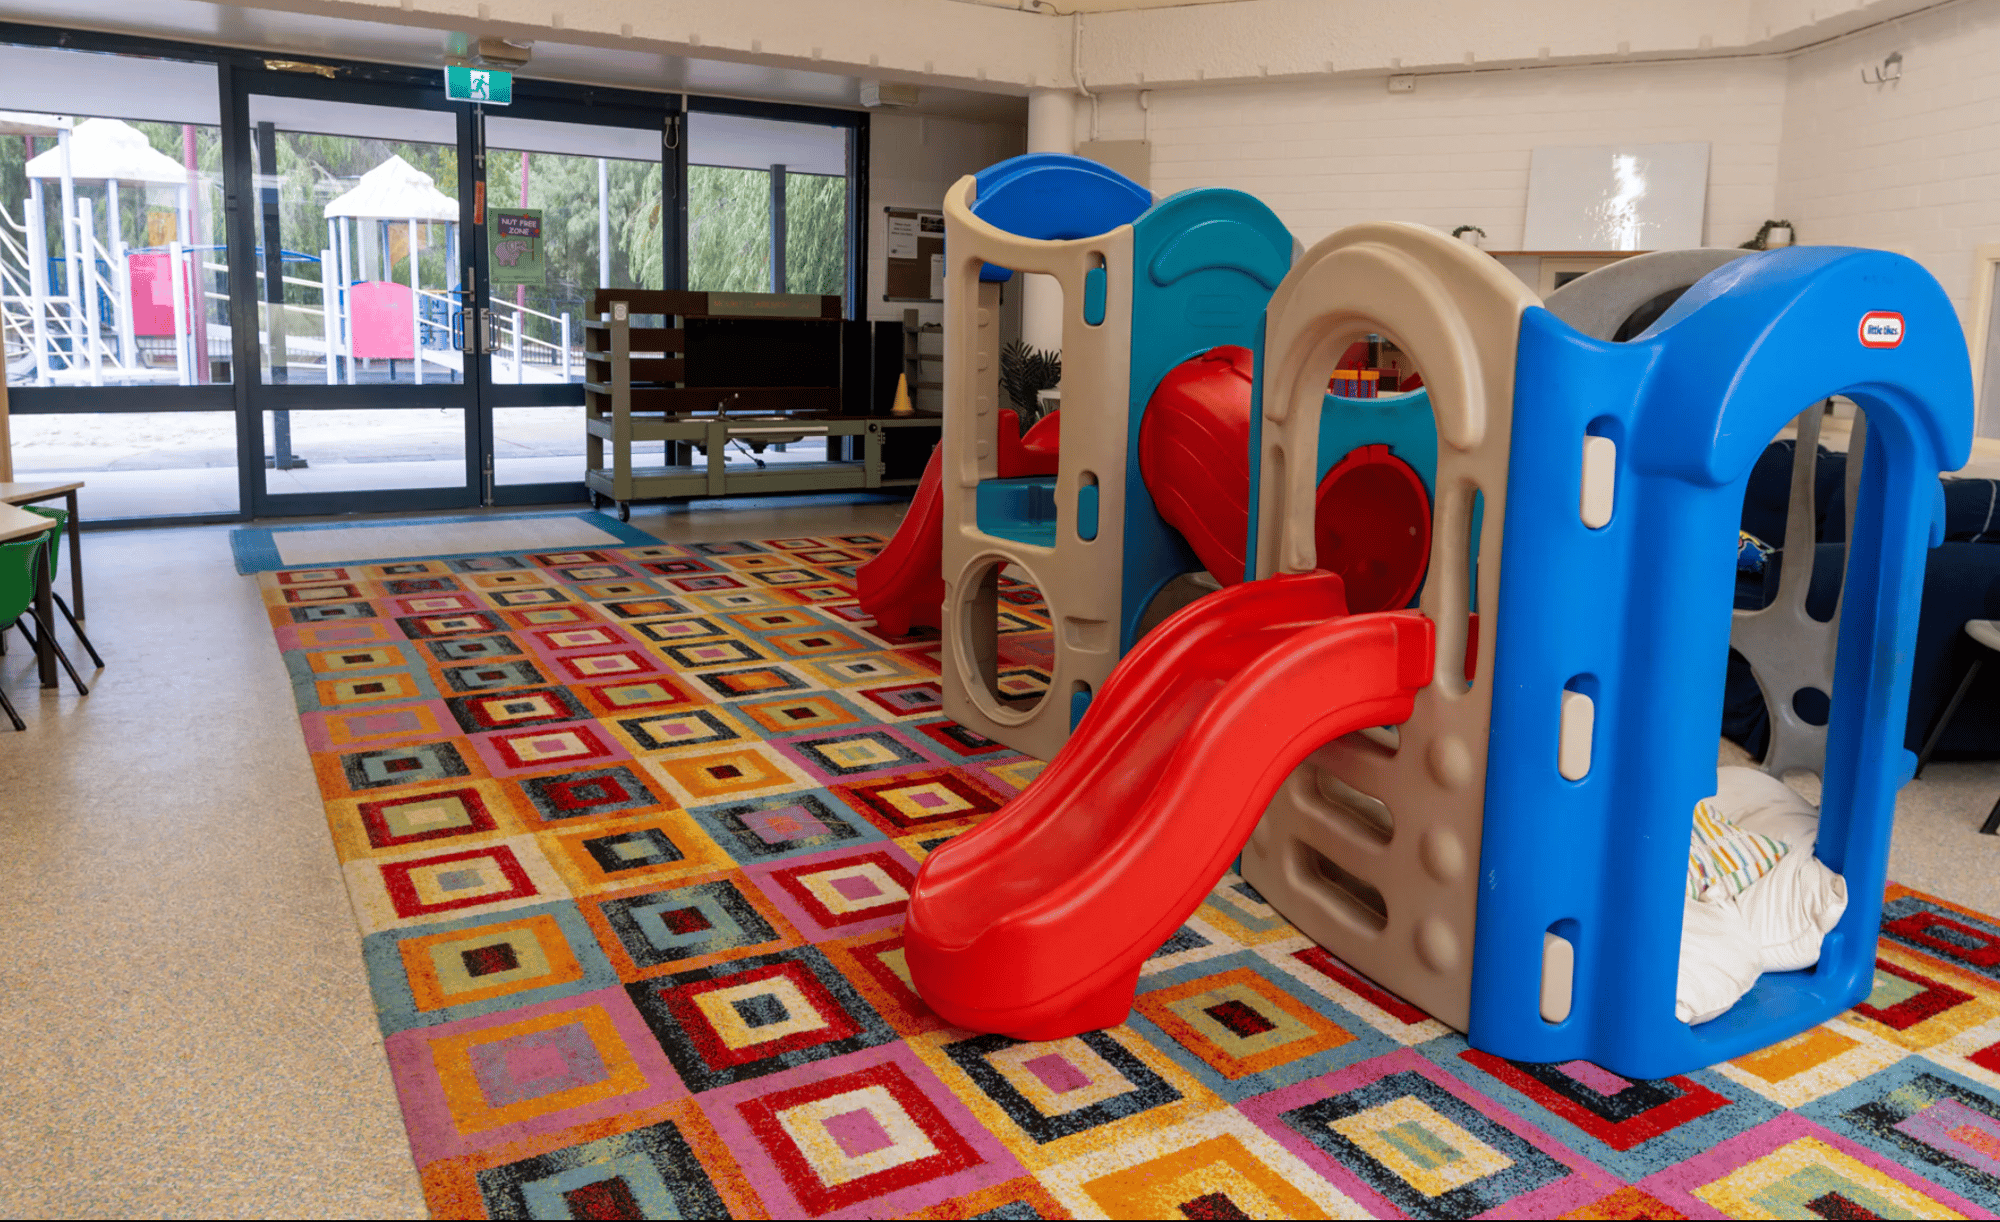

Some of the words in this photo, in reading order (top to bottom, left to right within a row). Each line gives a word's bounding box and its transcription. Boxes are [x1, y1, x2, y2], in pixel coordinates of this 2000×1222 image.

[519, 219, 537, 228] FREE
[508, 226, 529, 235] ZONE
[1868, 325, 1883, 334] little
